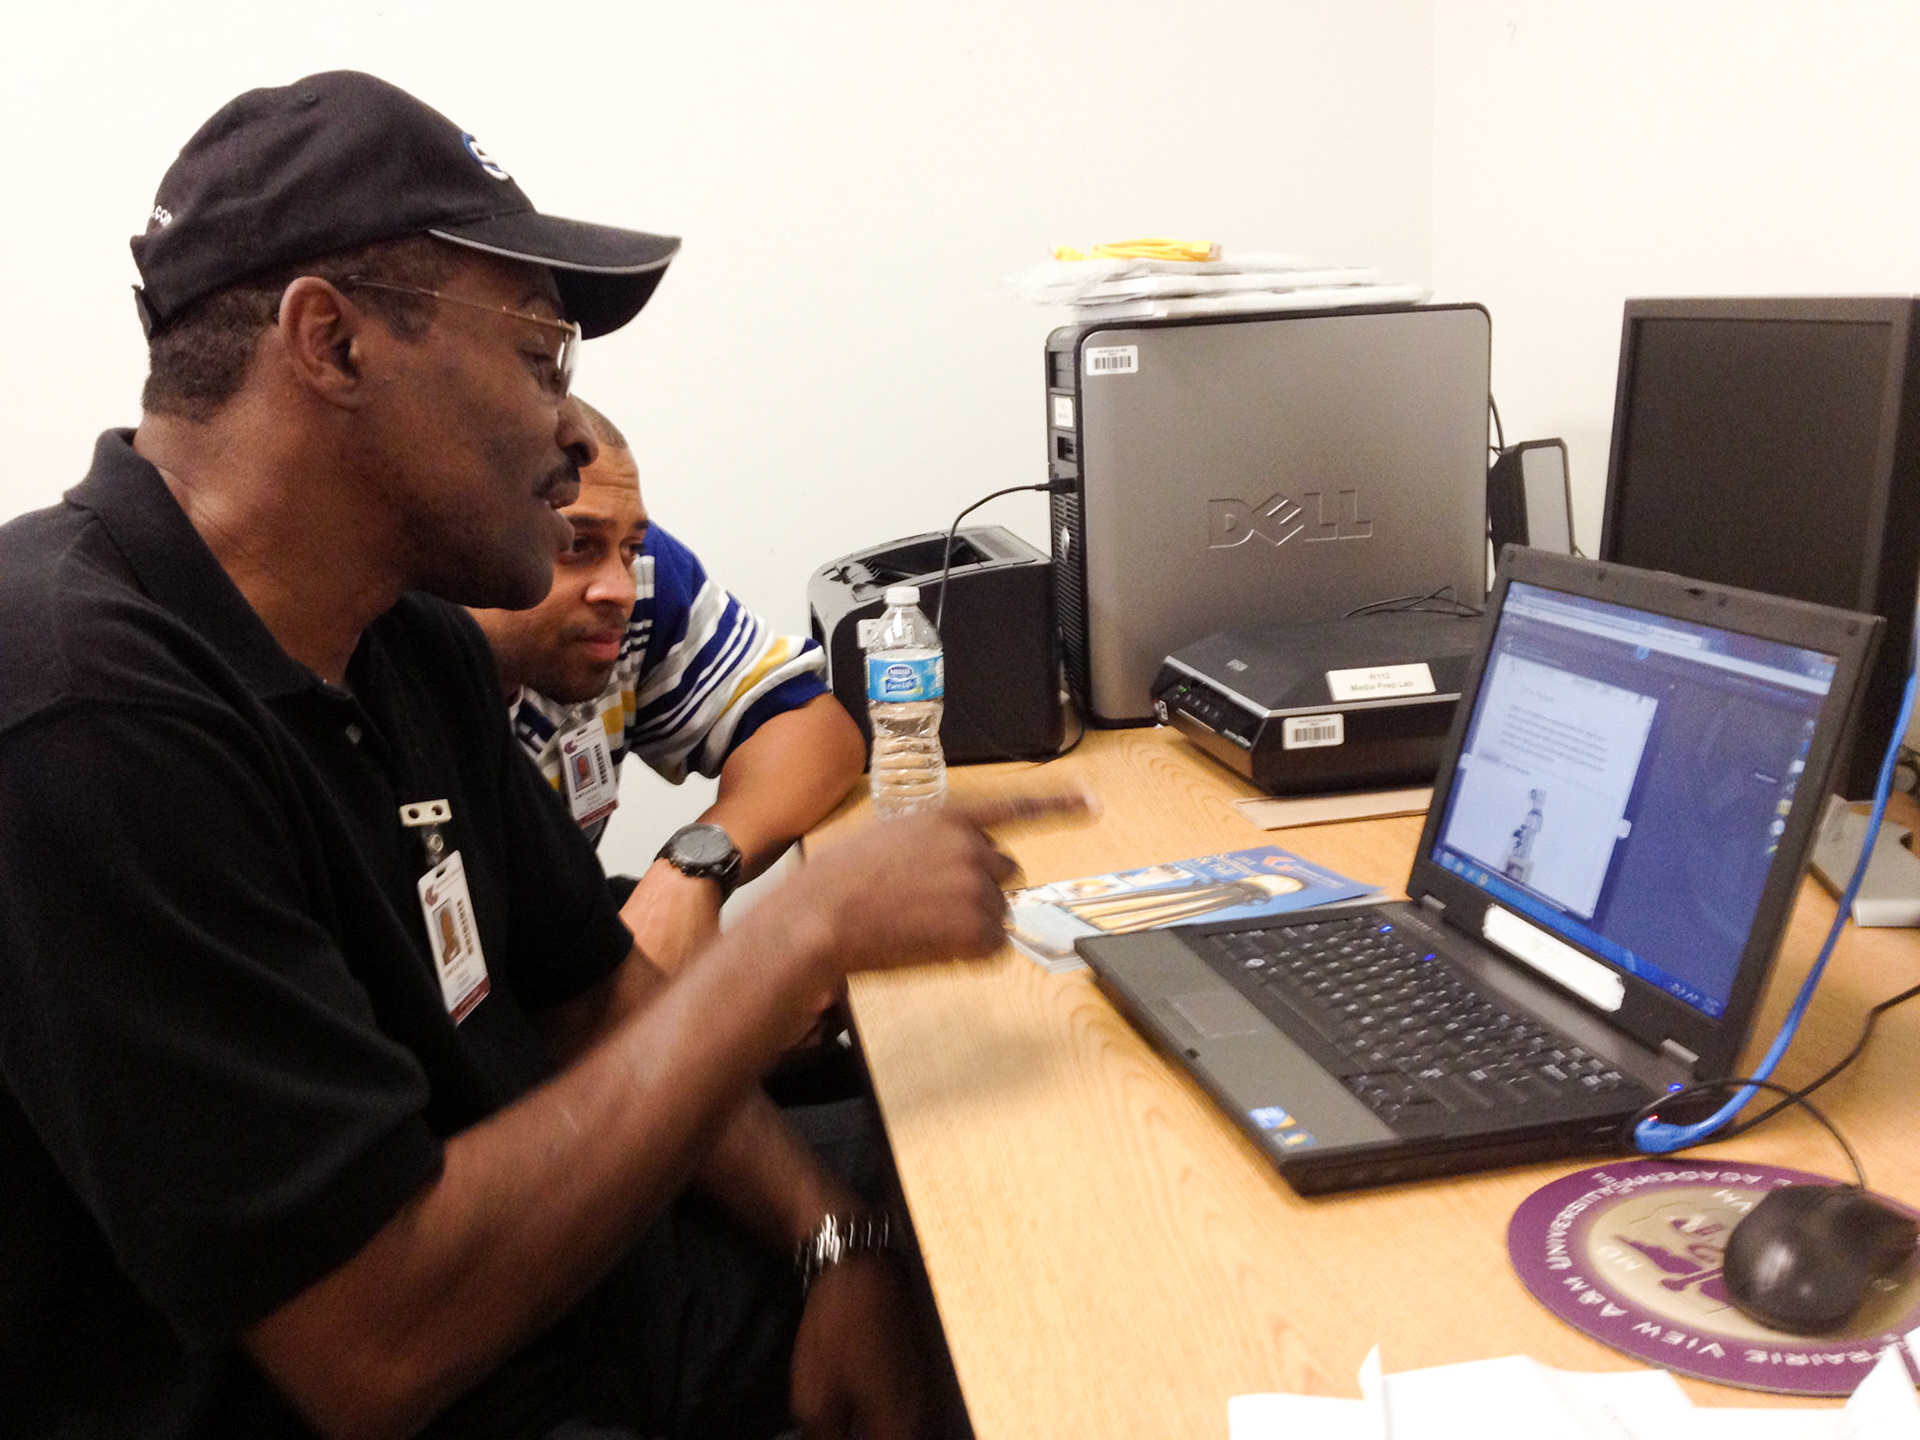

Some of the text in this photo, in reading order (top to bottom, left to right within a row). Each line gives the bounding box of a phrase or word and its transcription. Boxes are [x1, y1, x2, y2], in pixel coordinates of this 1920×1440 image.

[1208, 489, 1373, 549] DELL
[1563, 1277, 1627, 1317] A&M
[1632, 1322, 1726, 1359] VIEW
